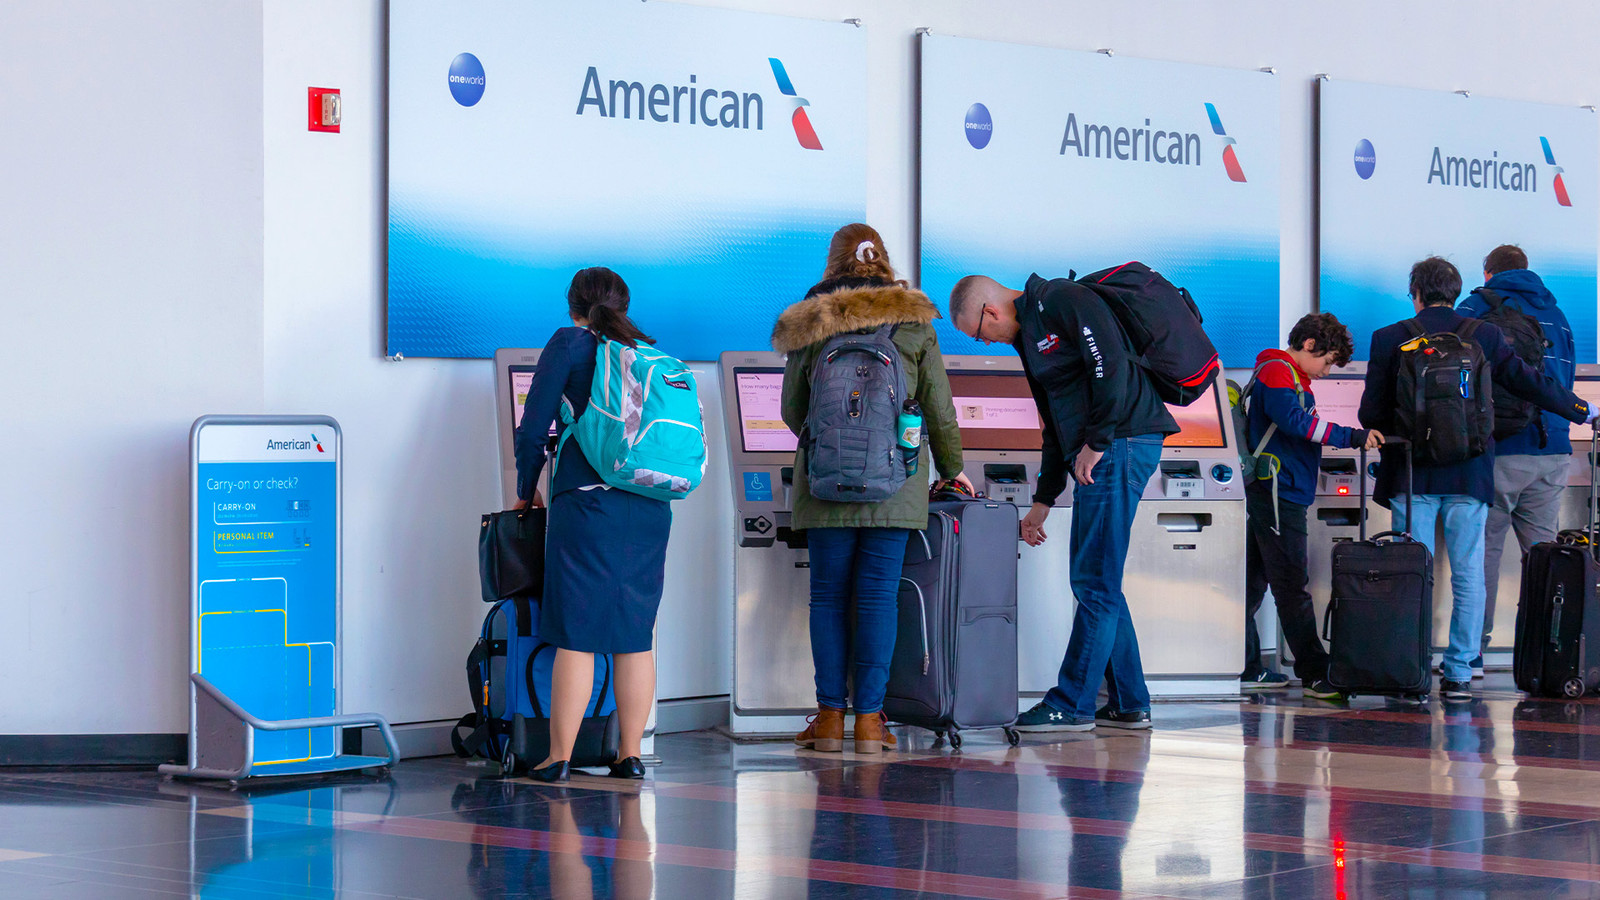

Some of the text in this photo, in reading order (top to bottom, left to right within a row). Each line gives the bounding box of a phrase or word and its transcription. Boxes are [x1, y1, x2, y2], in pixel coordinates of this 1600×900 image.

[449, 75, 484, 86] oneworld
[576, 65, 764, 131] American
[965, 122, 992, 131] oneworld
[1059, 112, 1201, 166] American
[1427, 146, 1537, 192] American
[1086, 336, 1104, 378] FINISHER
[266, 438, 311, 450] American
[206, 476, 299, 494] Carry-on or check?
[217, 503, 256, 511] CARRY-ON
[217, 531, 275, 541] PERSONAL ITEM
